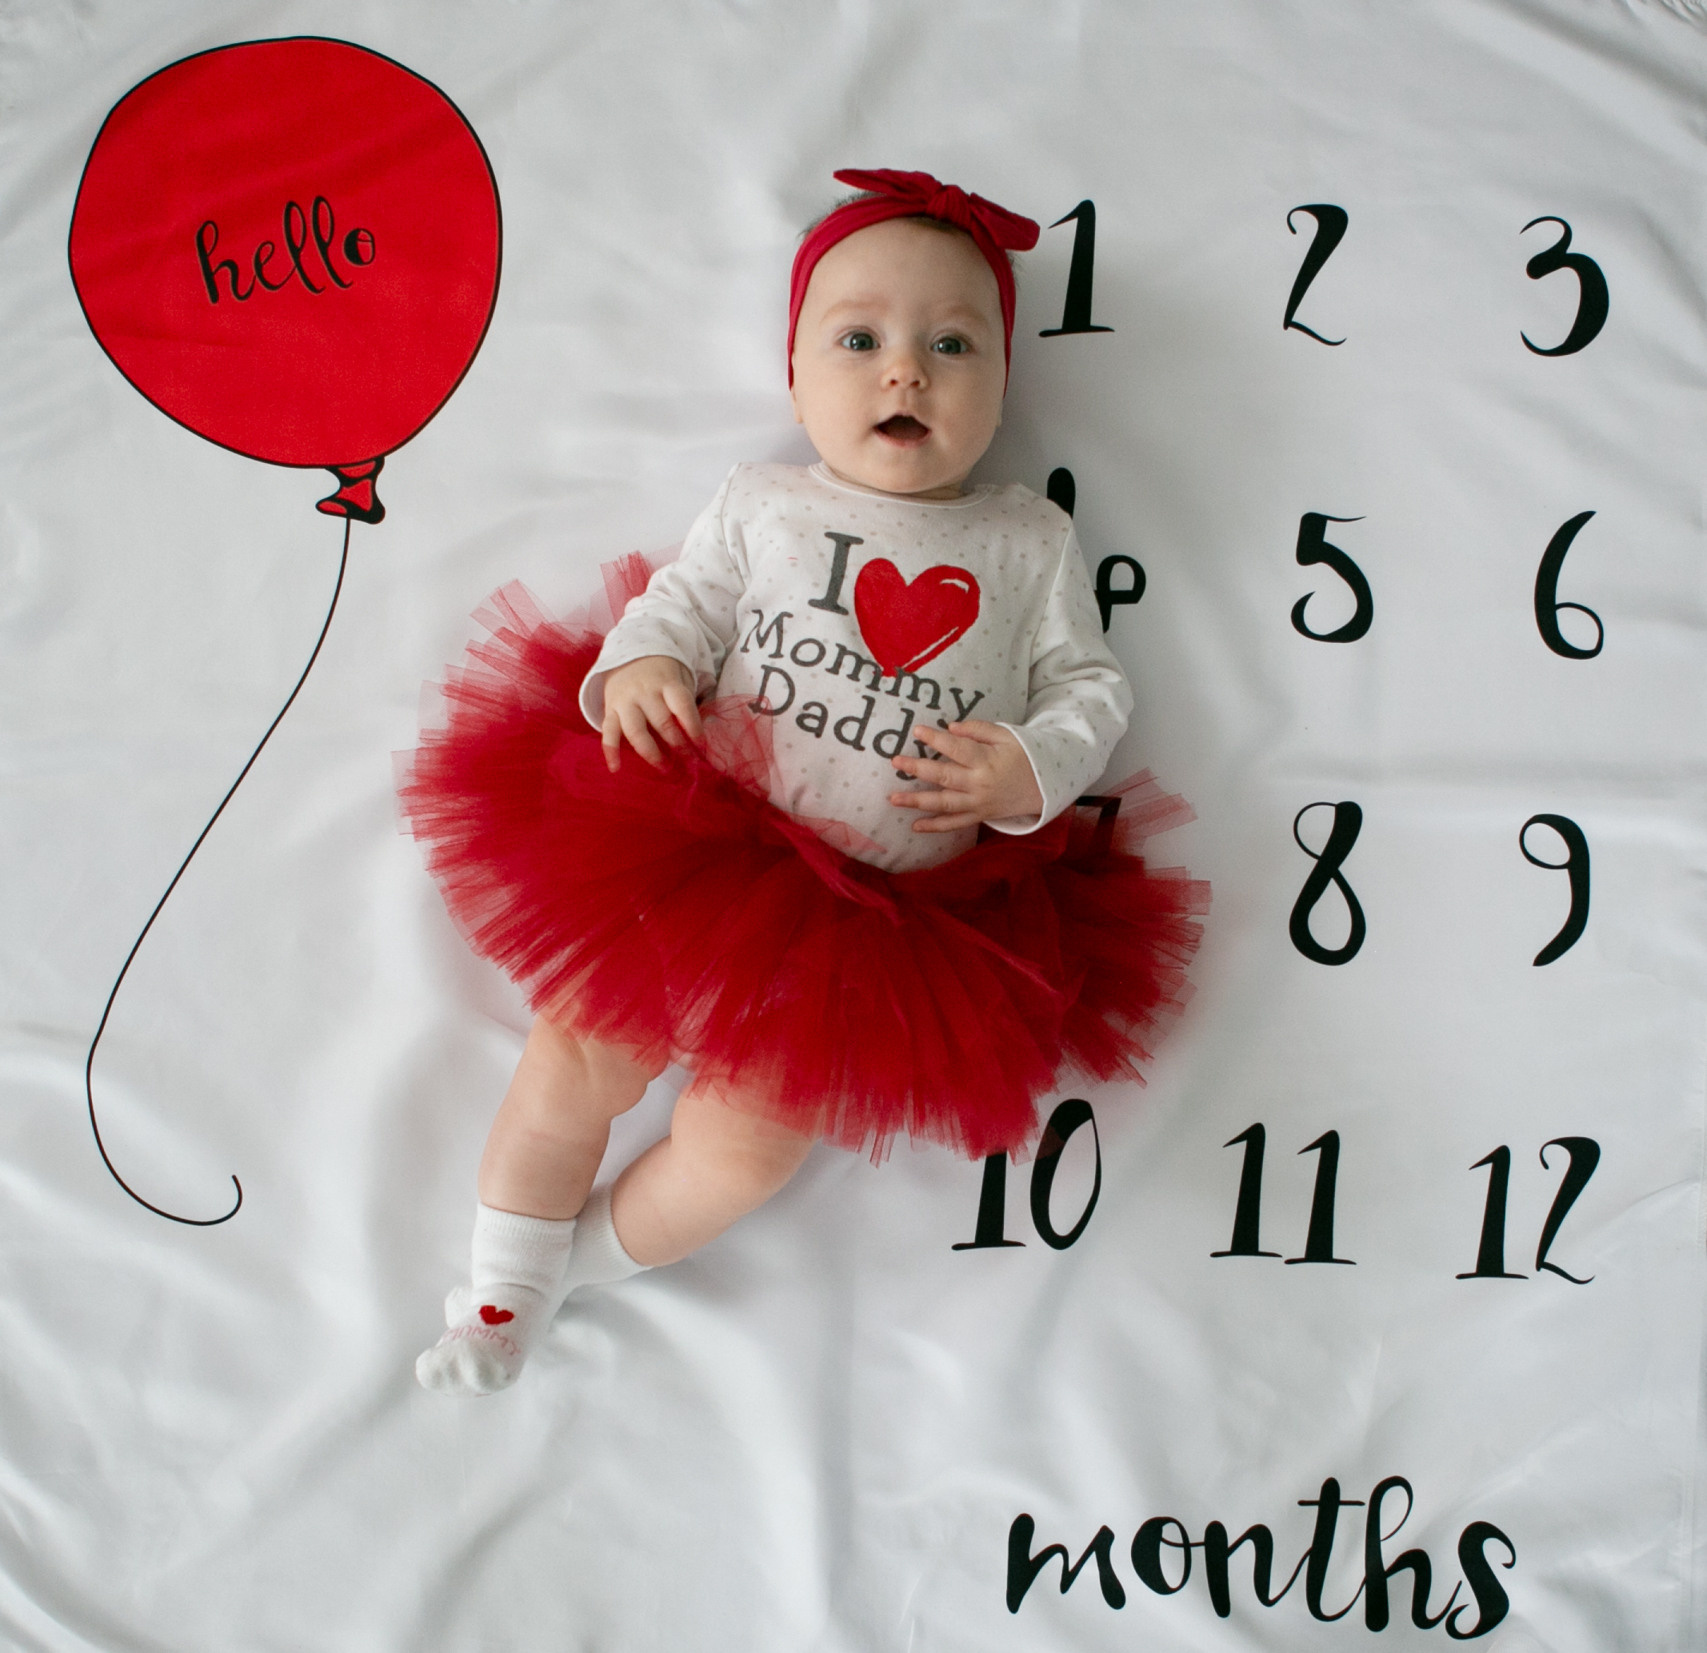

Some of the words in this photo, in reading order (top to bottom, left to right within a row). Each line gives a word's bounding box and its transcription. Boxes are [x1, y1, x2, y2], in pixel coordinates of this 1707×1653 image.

[195, 195, 375, 304] hello
[1038, 199, 1115, 338] 1
[1283, 204, 1348, 346] 2
[1520, 216, 1609, 356] 3
[808, 531, 864, 615] I
[1291, 512, 1373, 643] 5
[1535, 511, 1603, 659] 6
[740, 609, 985, 729] Mommy
[1289, 801, 1366, 966] 8
[1520, 814, 1590, 966] 9
[952, 1099, 1102, 1251] 10
[1210, 1122, 1356, 1265] 11
[1456, 1136, 1601, 1285] 12
[1006, 1475, 1517, 1641] months
